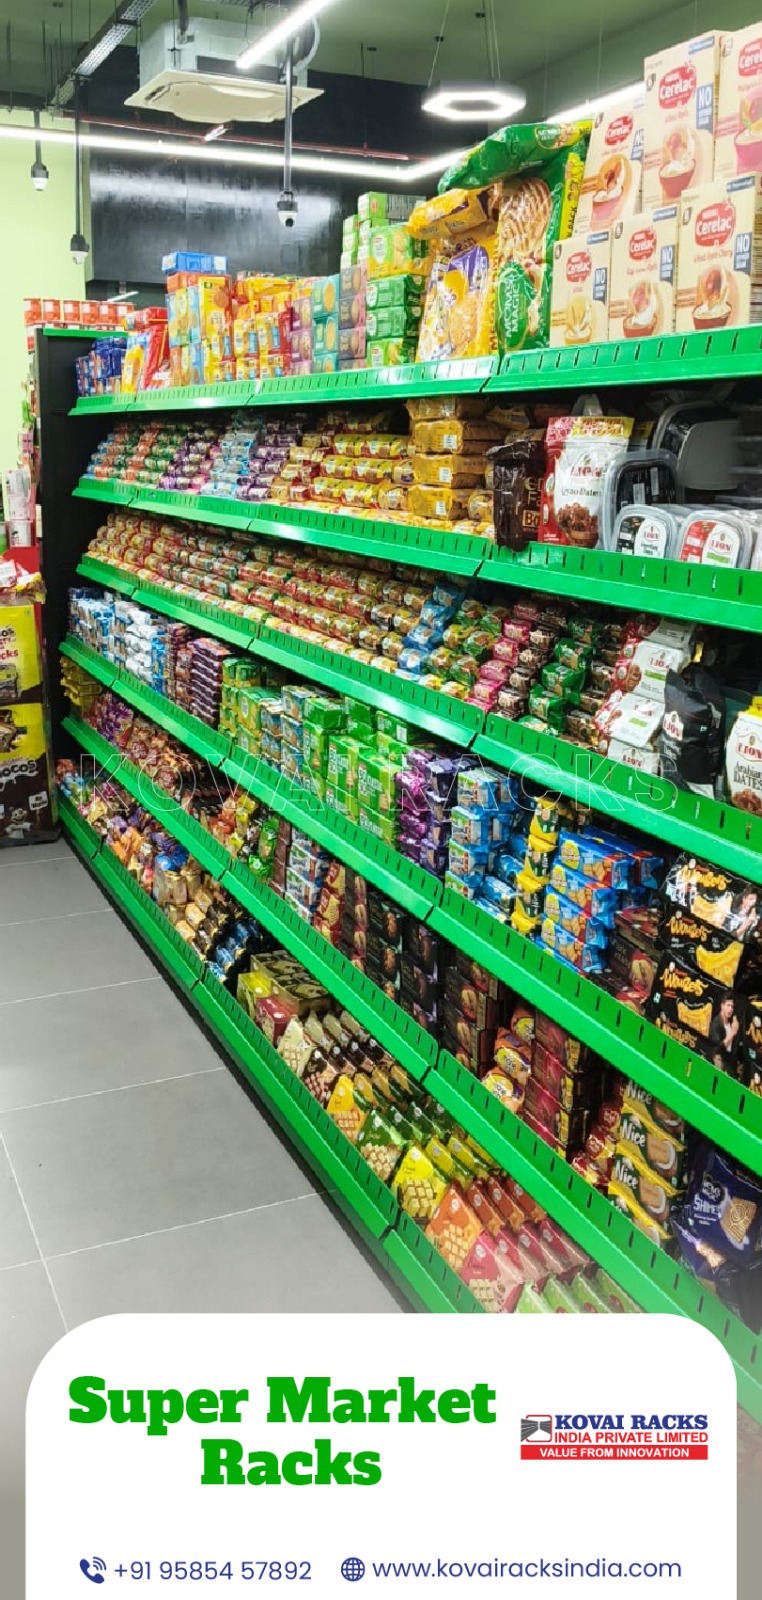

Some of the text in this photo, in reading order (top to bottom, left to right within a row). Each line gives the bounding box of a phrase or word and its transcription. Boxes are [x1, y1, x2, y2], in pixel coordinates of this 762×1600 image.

[660, 77, 696, 99] Cerelac
[699, 86, 713, 108] NO
[696, 217, 733, 236] Cerelac
[737, 233, 750, 253] NO
[626, 1080, 653, 1105] Nice
[621, 1118, 646, 1147] Nice
[614, 1159, 639, 1190] Nice
